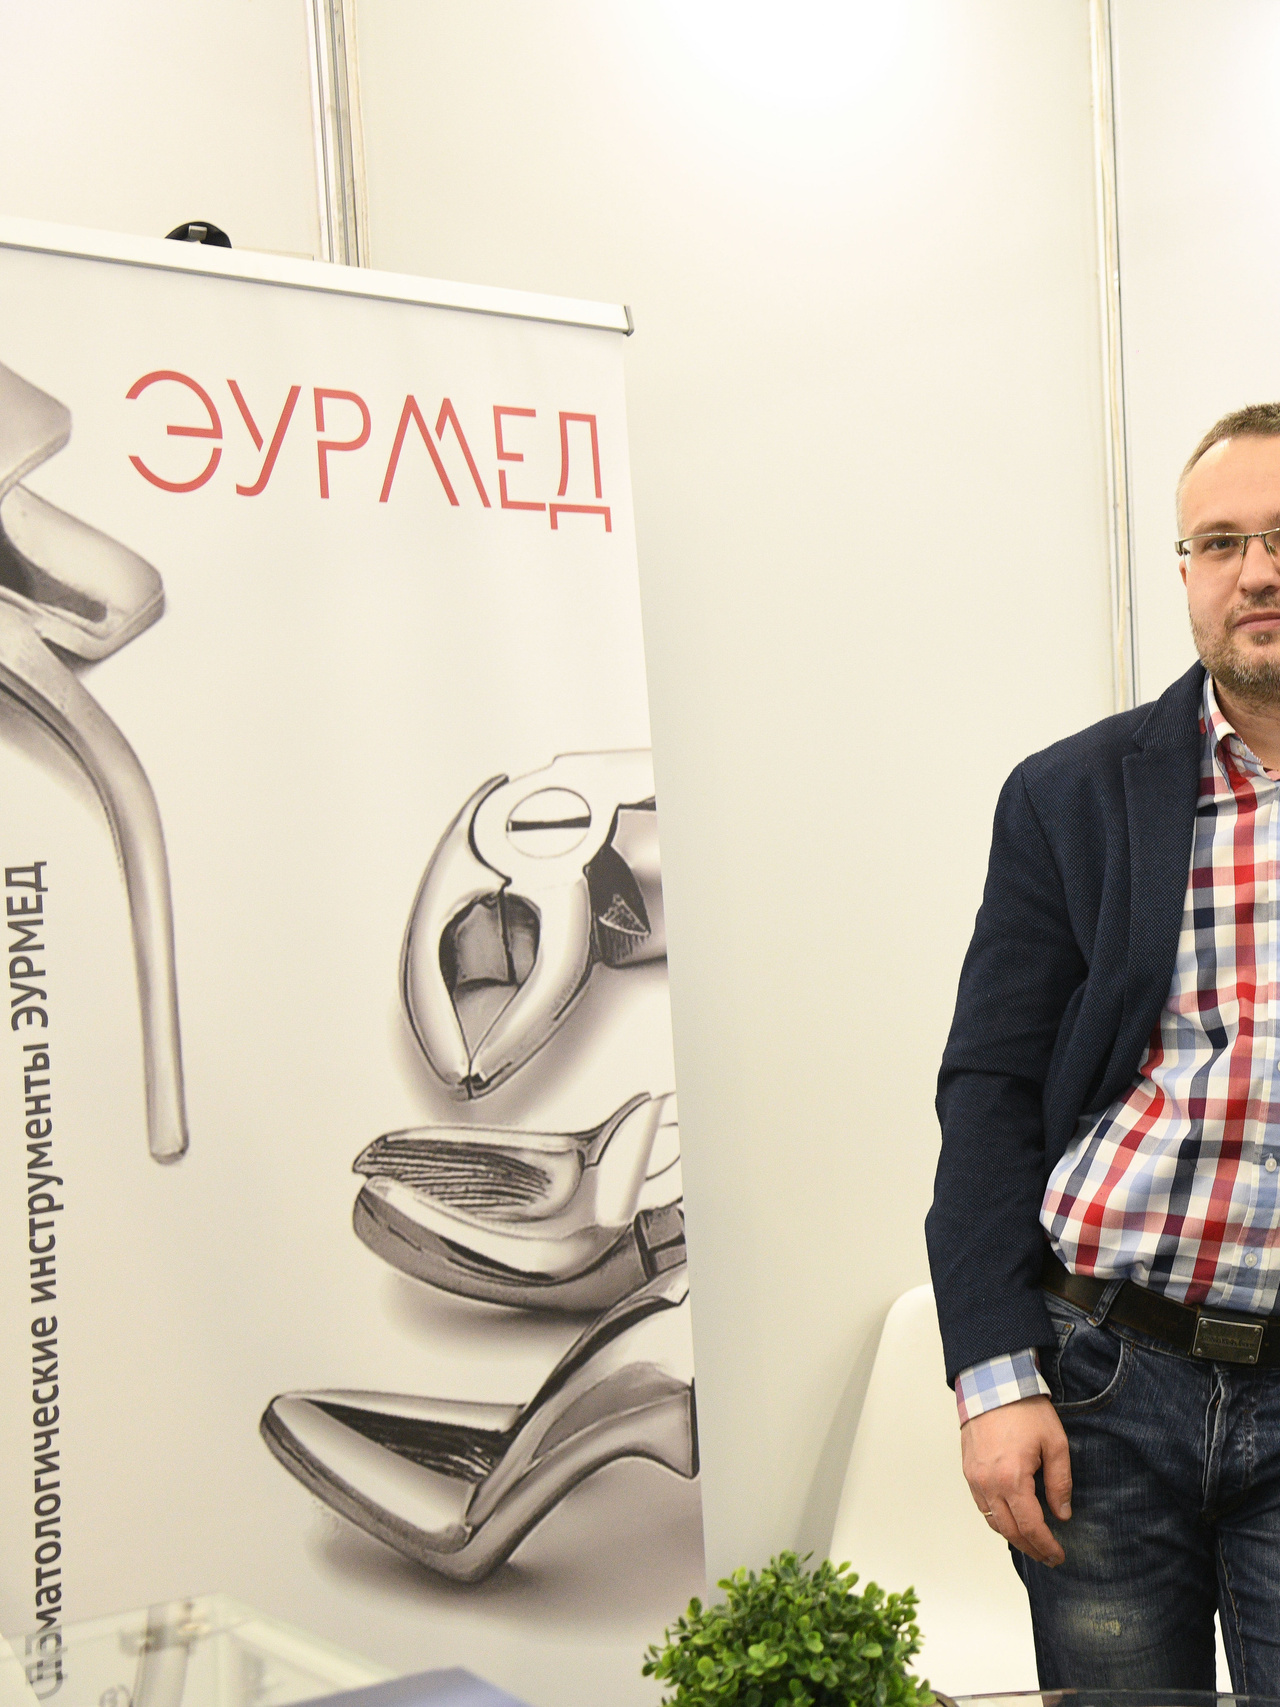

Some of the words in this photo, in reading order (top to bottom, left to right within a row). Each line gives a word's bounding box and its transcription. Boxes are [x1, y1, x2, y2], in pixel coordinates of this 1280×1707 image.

[125, 370, 612, 533] ЭУРМЕД
[5, 861, 48, 1030] ЭУРМЕД
[22, 1044, 63, 1304] инструменты
[26, 1316, 63, 1700] оматологические
